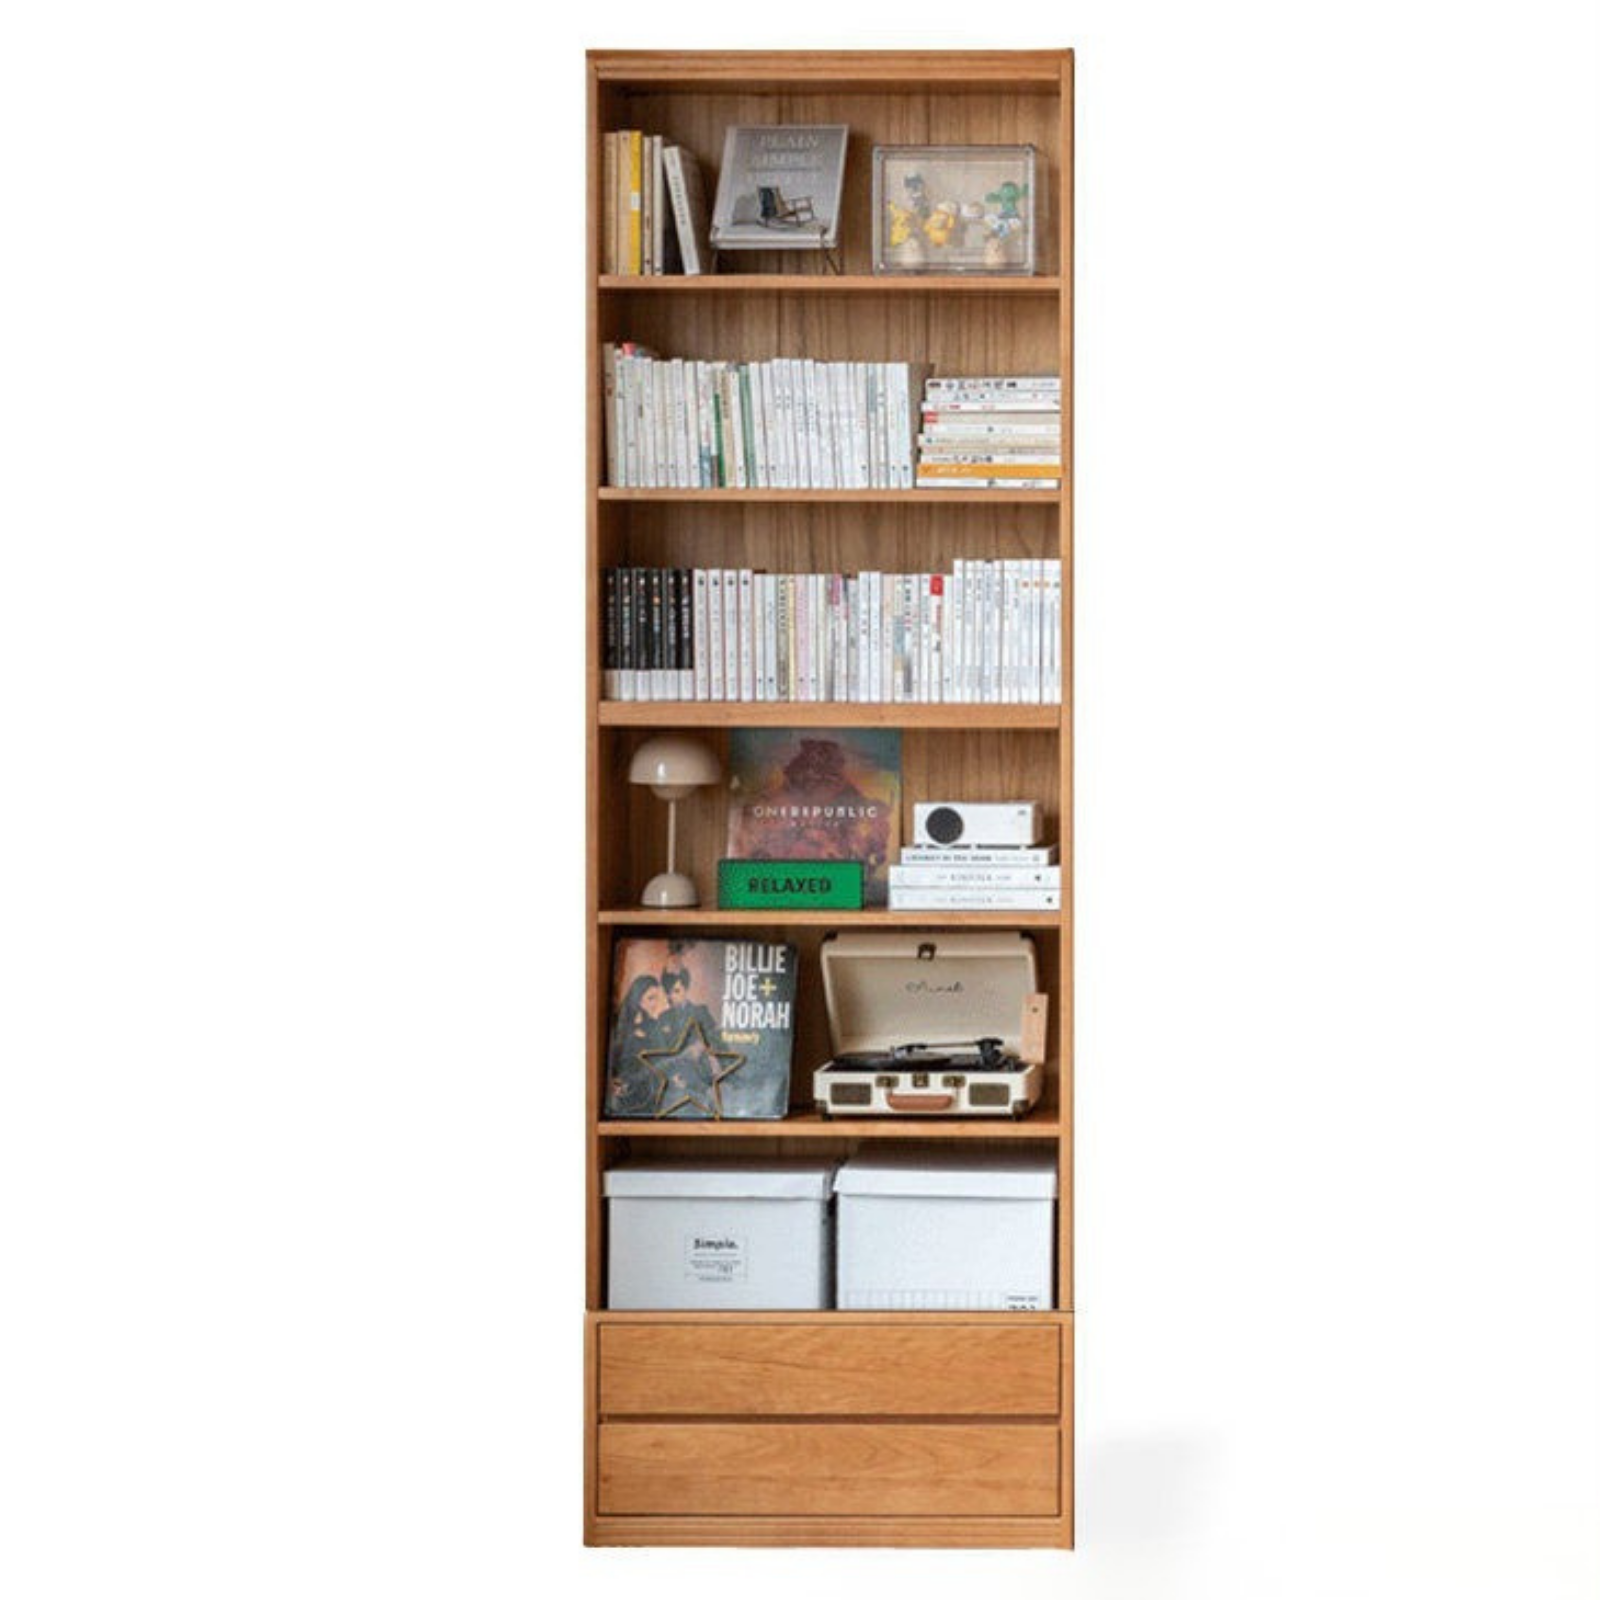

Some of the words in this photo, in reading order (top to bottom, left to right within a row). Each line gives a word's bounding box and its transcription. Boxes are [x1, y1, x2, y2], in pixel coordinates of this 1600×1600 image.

[748, 877, 833, 894] RELAXED
[724, 943, 787, 973] BILLIE
[721, 1001, 790, 1029] NORAH
